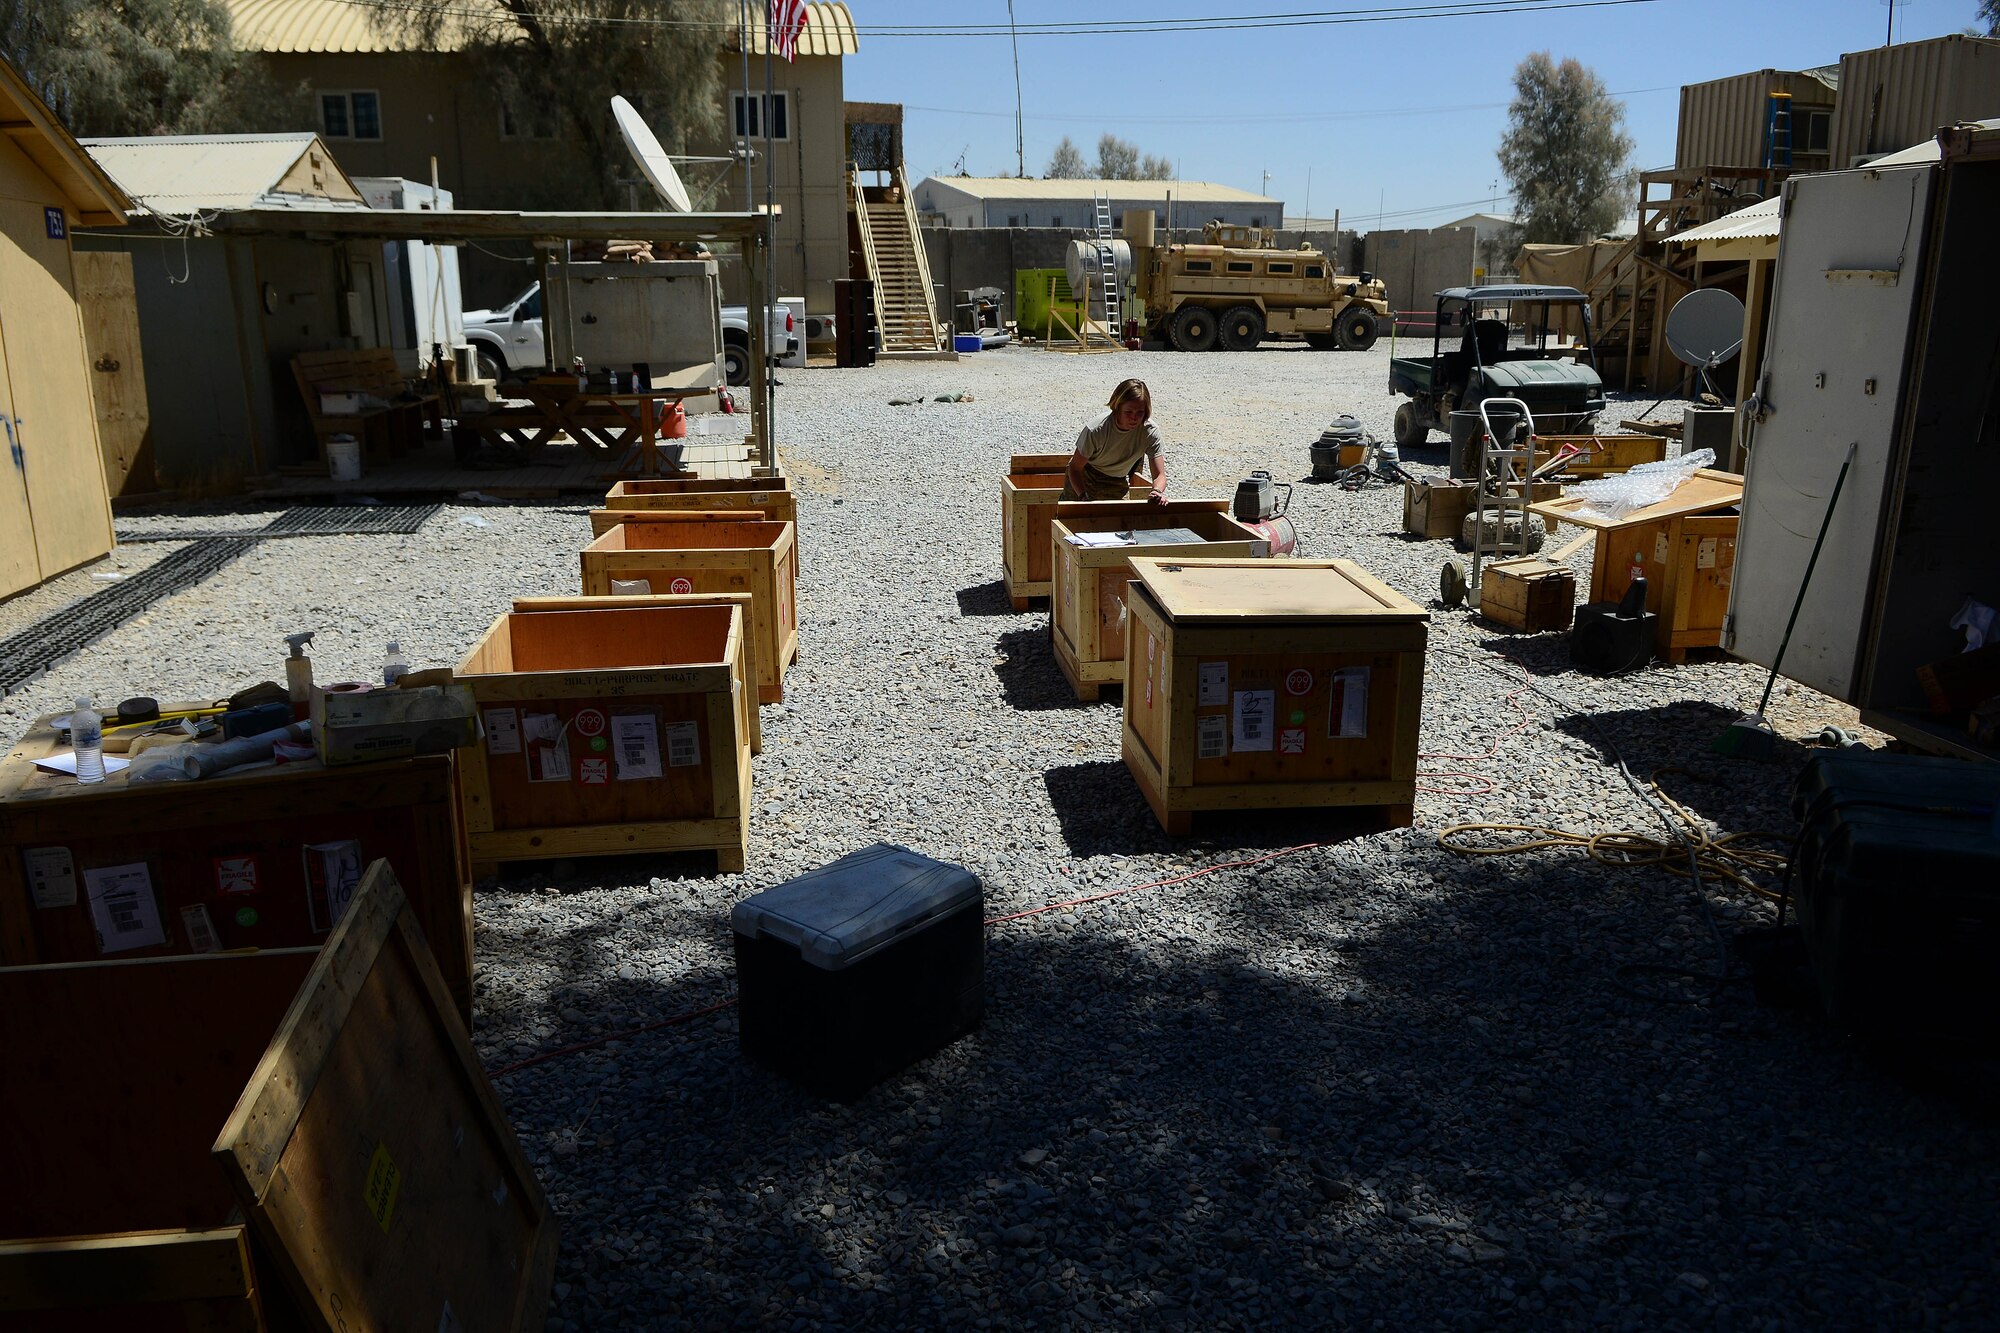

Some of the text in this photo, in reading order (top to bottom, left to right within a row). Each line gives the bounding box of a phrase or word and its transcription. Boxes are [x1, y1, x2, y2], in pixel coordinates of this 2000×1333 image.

[47, 210, 63, 236] 753
[610, 685, 626, 695] 35
[579, 715, 601, 727] 999
[1281, 737, 1304, 746] FRAGILE
[582, 767, 606, 775] FRAGILE
[220, 870, 254, 881] FRAGILE
[376, 1161, 396, 1223] CLEARED
